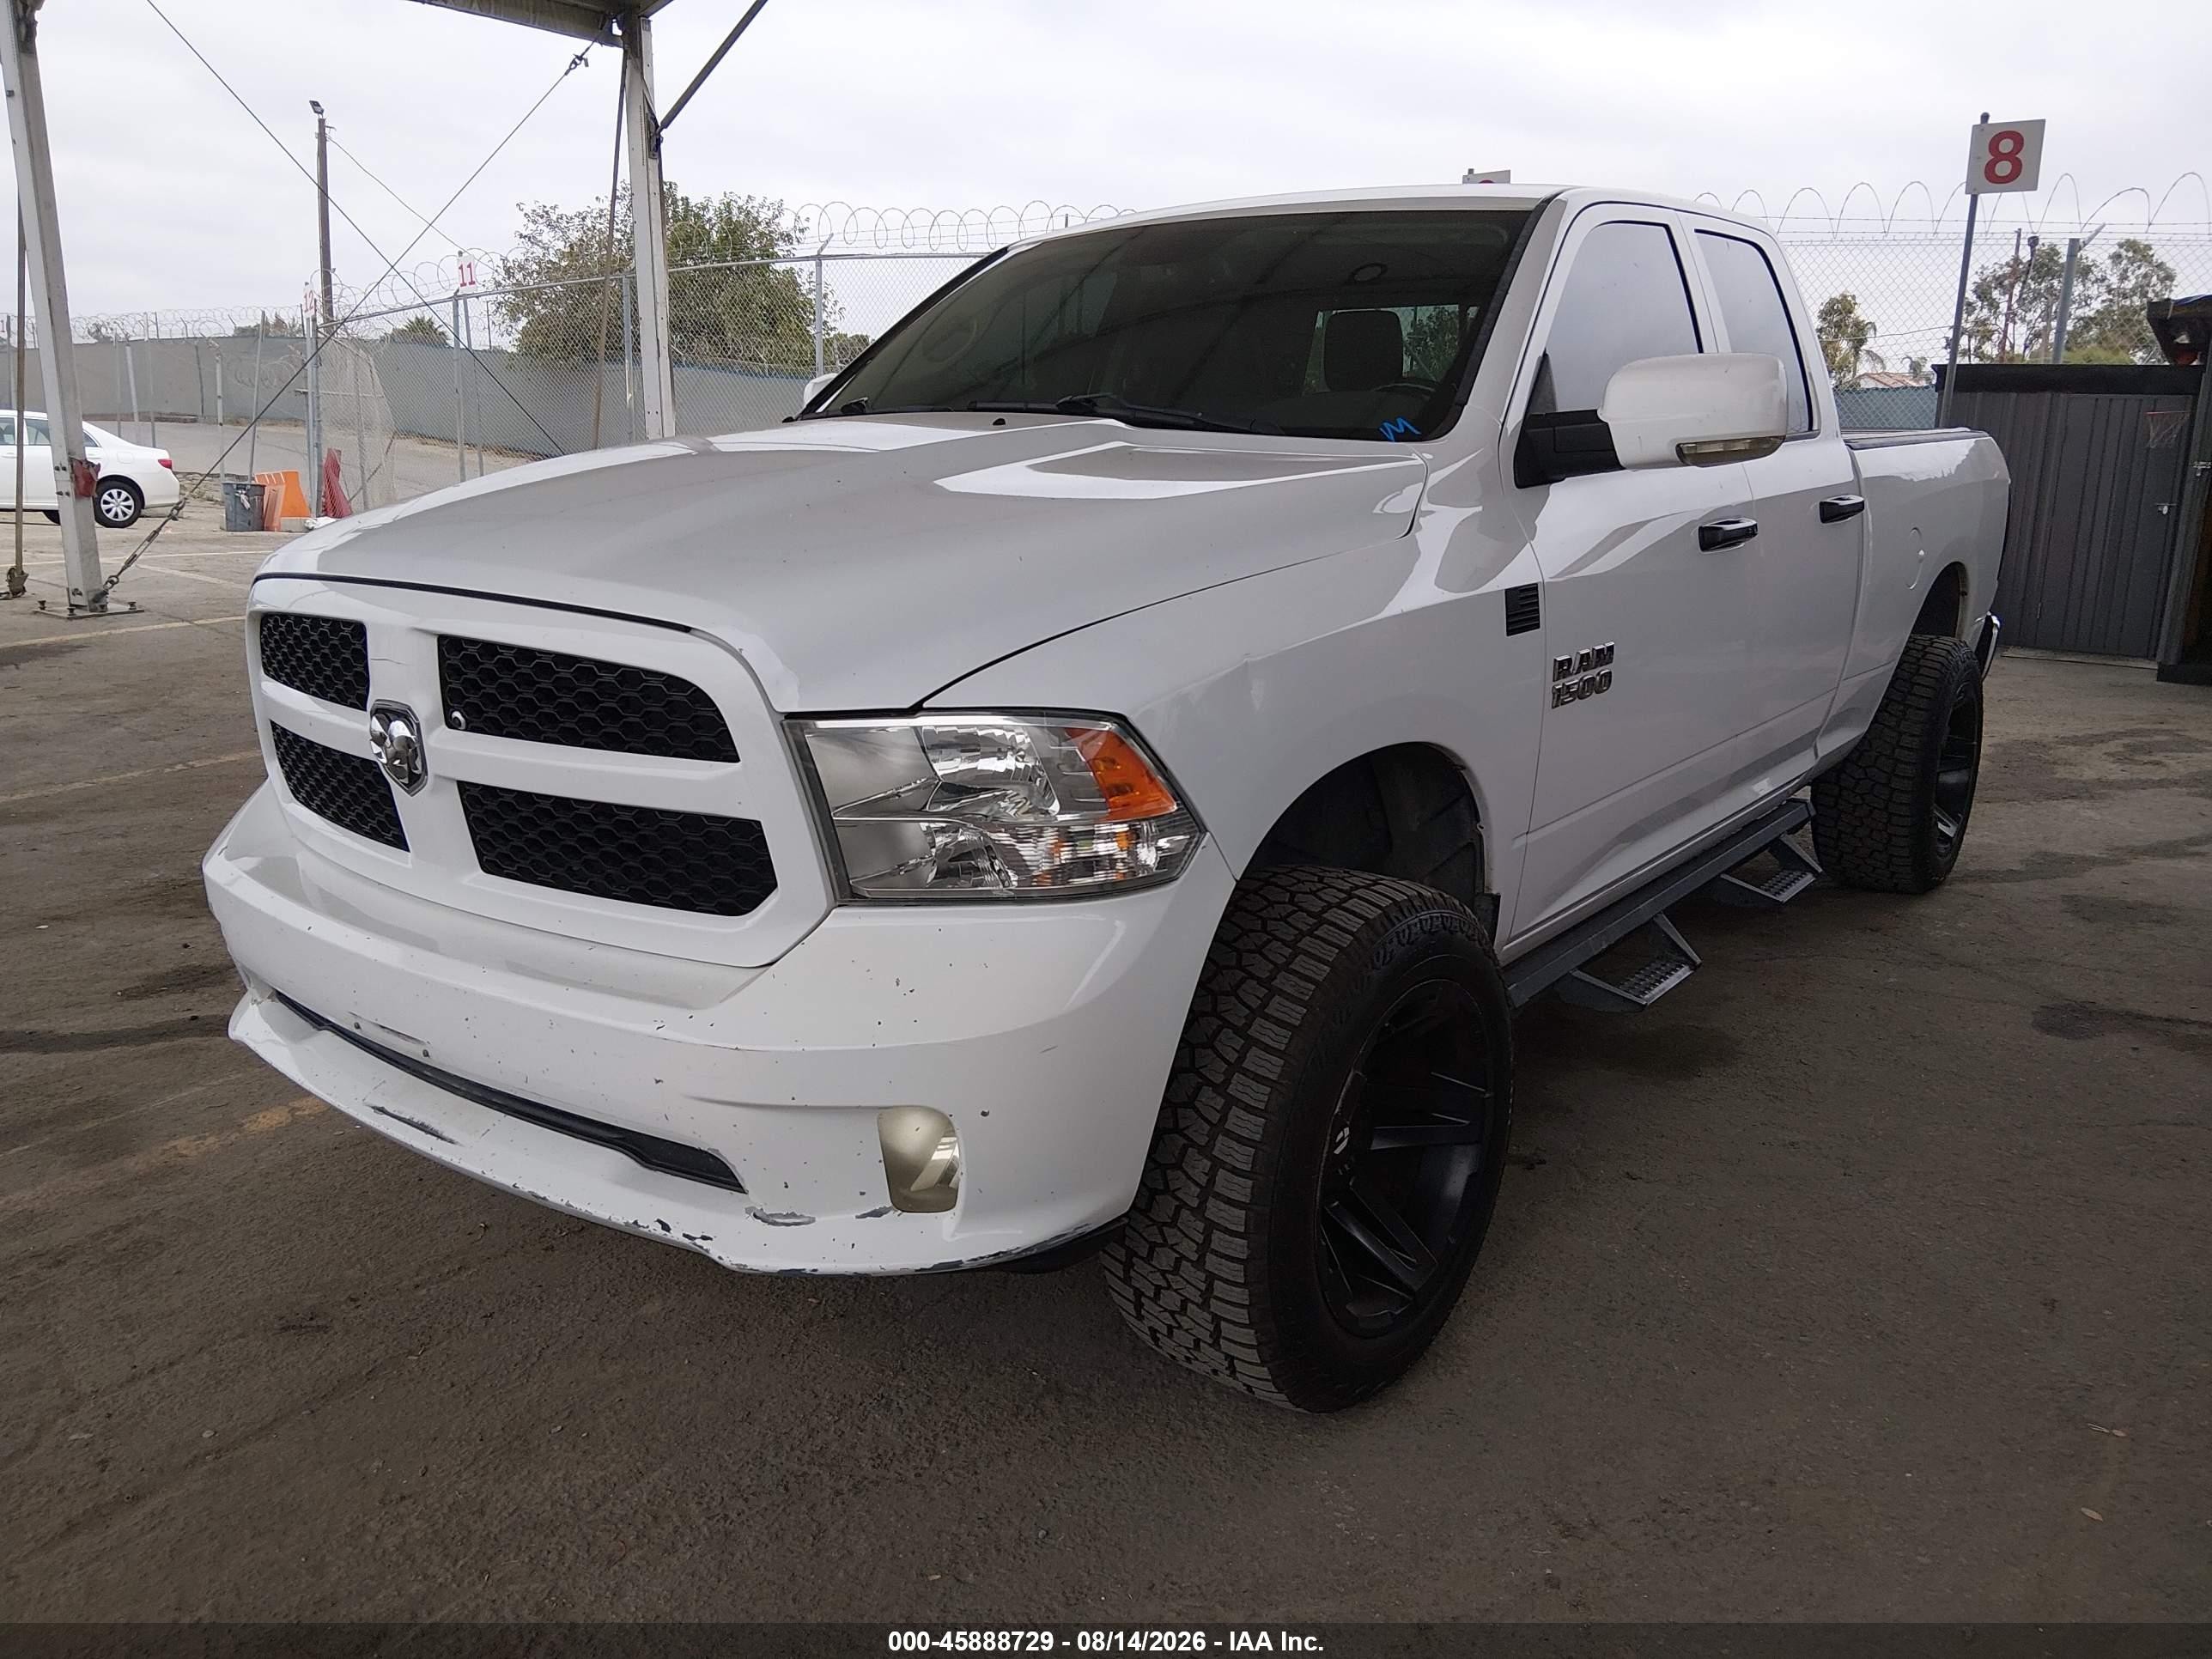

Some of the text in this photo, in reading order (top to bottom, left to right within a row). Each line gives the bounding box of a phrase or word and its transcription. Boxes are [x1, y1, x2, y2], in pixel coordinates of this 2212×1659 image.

[1984, 130, 2025, 185] 8
[459, 262, 476, 288] 11
[303, 289, 314, 313] 12
[1553, 641, 1615, 683] RAM
[1551, 669, 1613, 709] 1500
